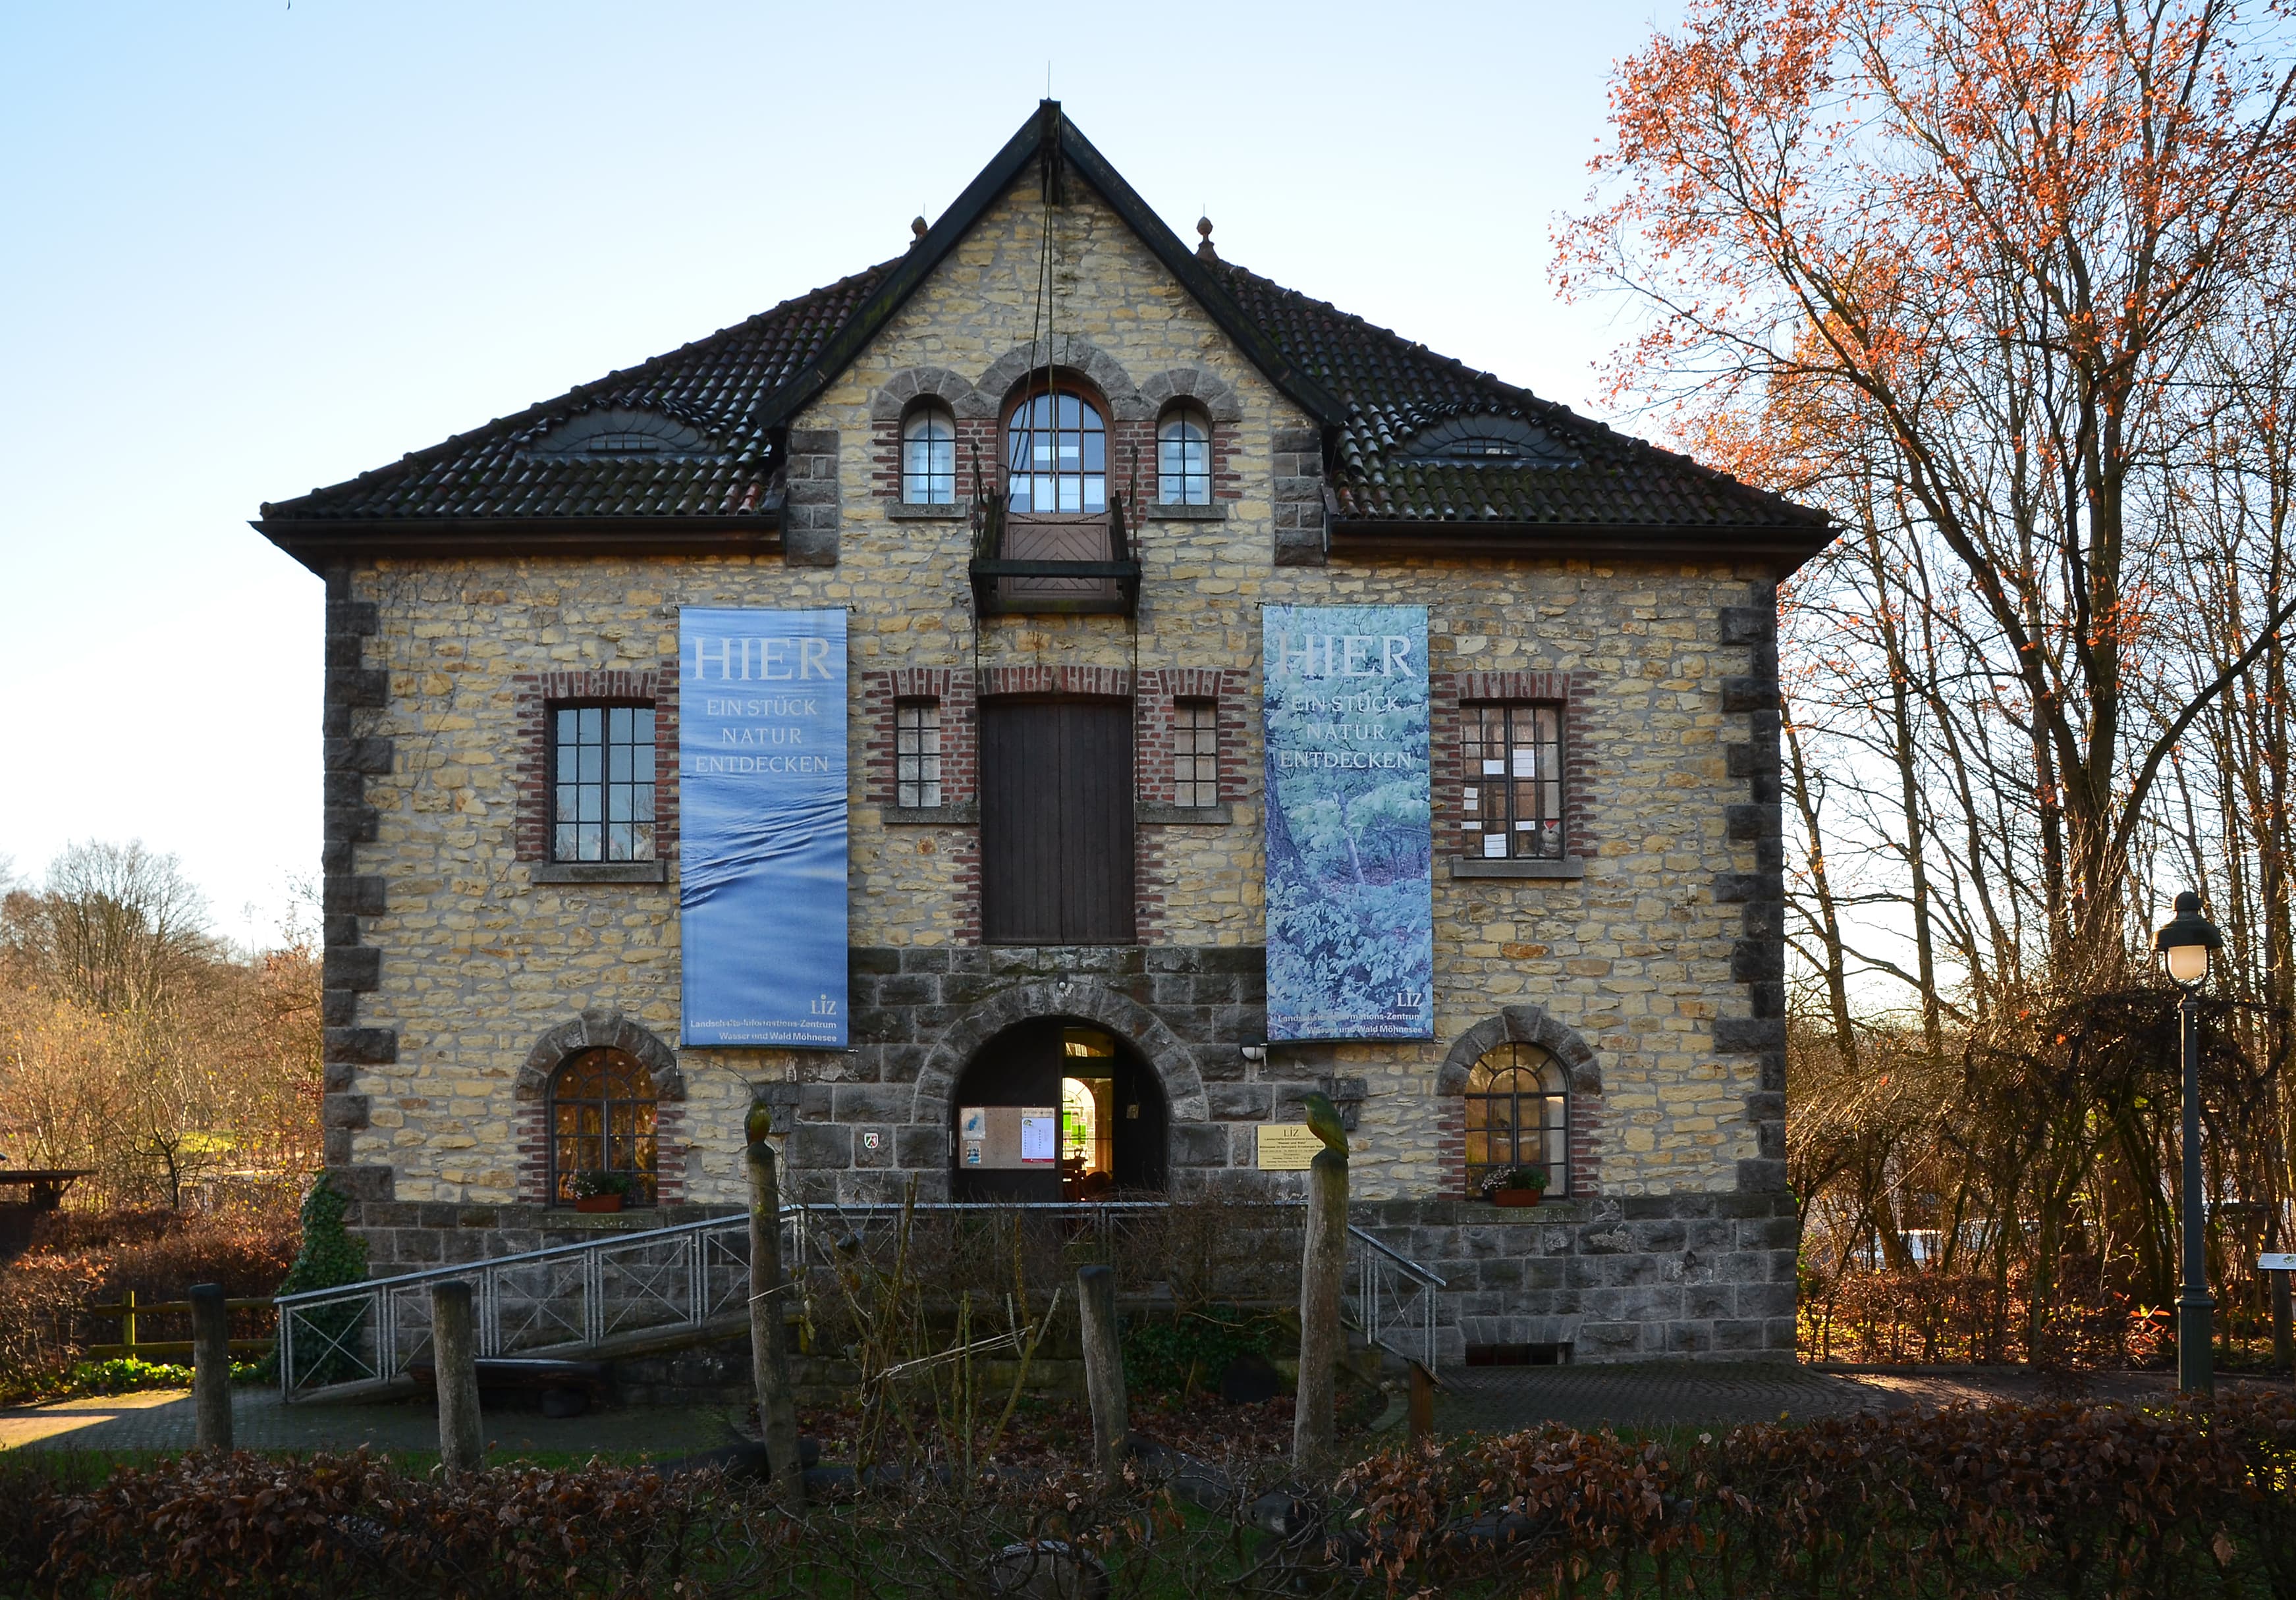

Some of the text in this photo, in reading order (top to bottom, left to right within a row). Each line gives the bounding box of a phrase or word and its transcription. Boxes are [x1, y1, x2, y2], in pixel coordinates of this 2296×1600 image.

[693, 637, 835, 681] HIER
[1277, 633, 1419, 677] HIER
[707, 696, 817, 716] EIN STÜCK
[1292, 691, 1400, 712] EIN STÜCK
[723, 728, 802, 744] NATUR
[1307, 724, 1385, 740] NATUR
[696, 756, 828, 772] ENTDECKEN
[1280, 752, 1411, 768] ENTDECKEN
[793, 1032, 837, 1042] Möhnesee
[1380, 1025, 1423, 1033] Möhnesee
